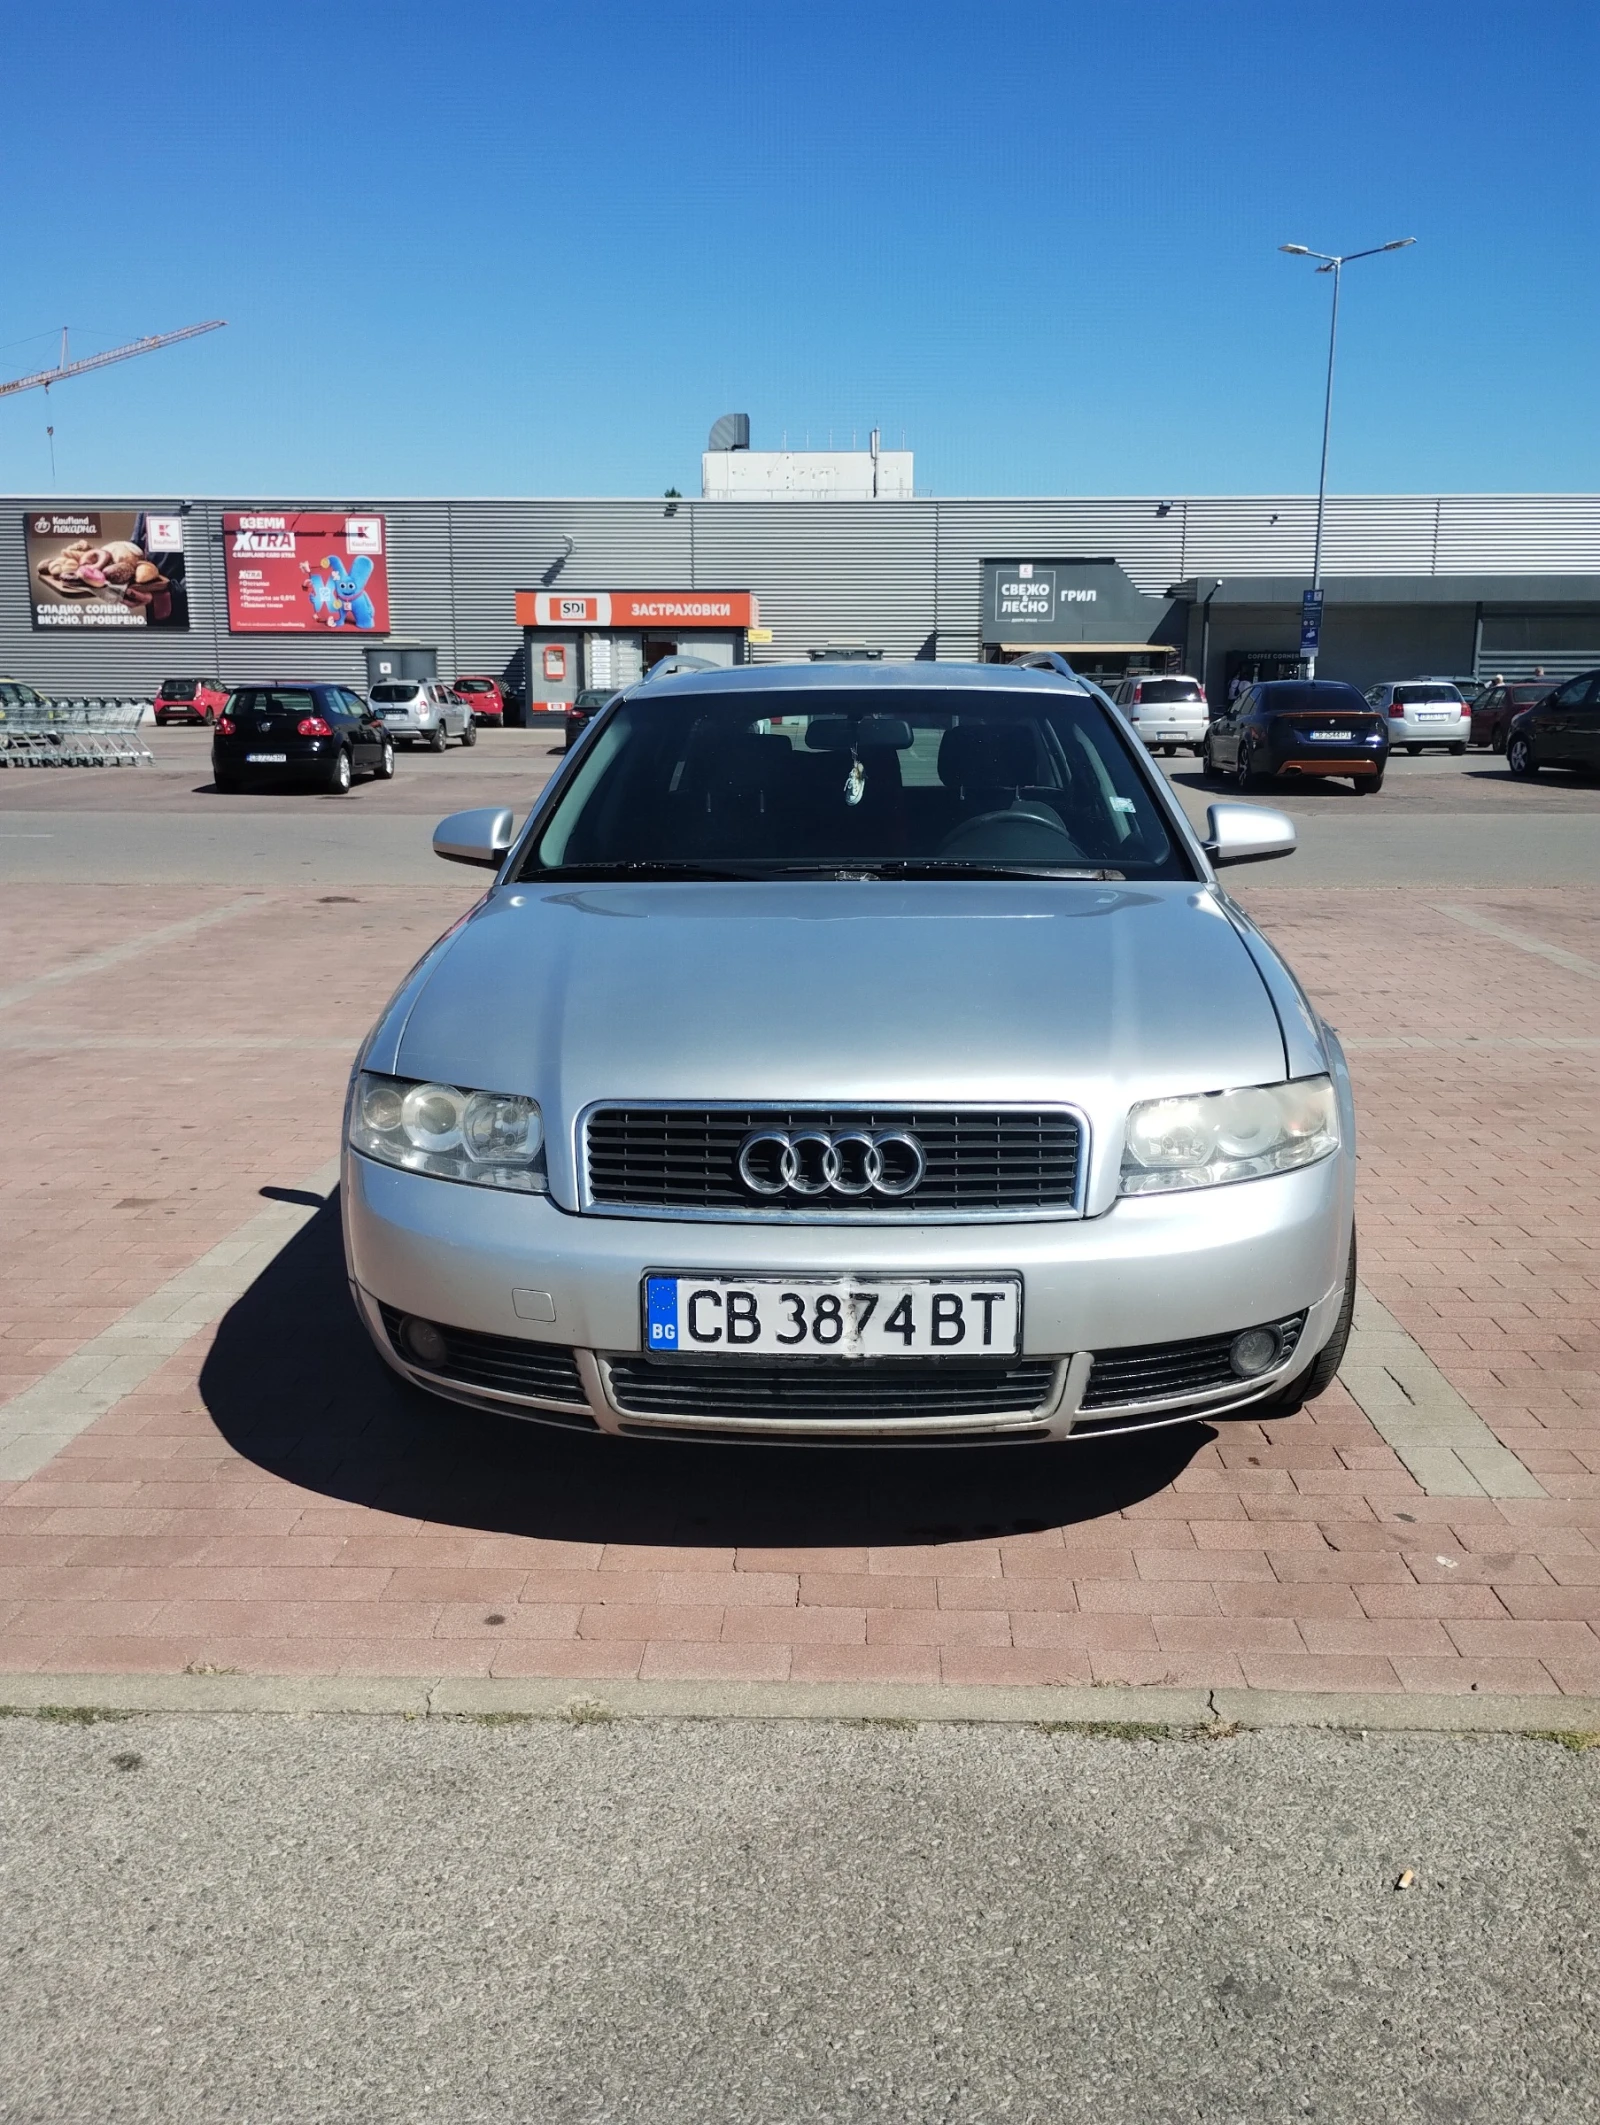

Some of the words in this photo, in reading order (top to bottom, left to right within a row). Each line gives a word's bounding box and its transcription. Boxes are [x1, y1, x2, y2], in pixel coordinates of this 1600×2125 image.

[52, 516, 89, 525] Kaufland
[240, 517, 285, 529] ВЗЕМИ
[53, 524, 97, 534] пекарна
[233, 531, 296, 551] XTRA
[1001, 584, 1050, 596] СВЕЖО
[1060, 590, 1097, 602] ГРИЛ
[36, 604, 84, 615] СЛАДКО.
[85, 604, 130, 614] СОЛЕНО.
[563, 603, 584, 613] SDI
[631, 603, 730, 616] ЗАСТРАХОВКИ
[1001, 601, 1048, 613] ЛЕСНО
[38, 615, 81, 625] ВКУСНО.
[83, 615, 147, 625] ПРОВЕРЕНО.
[688, 1289, 761, 1344] CB
[776, 1292, 916, 1346] 3874
[931, 1292, 1006, 1346] BT
[652, 1323, 676, 1340] BG
